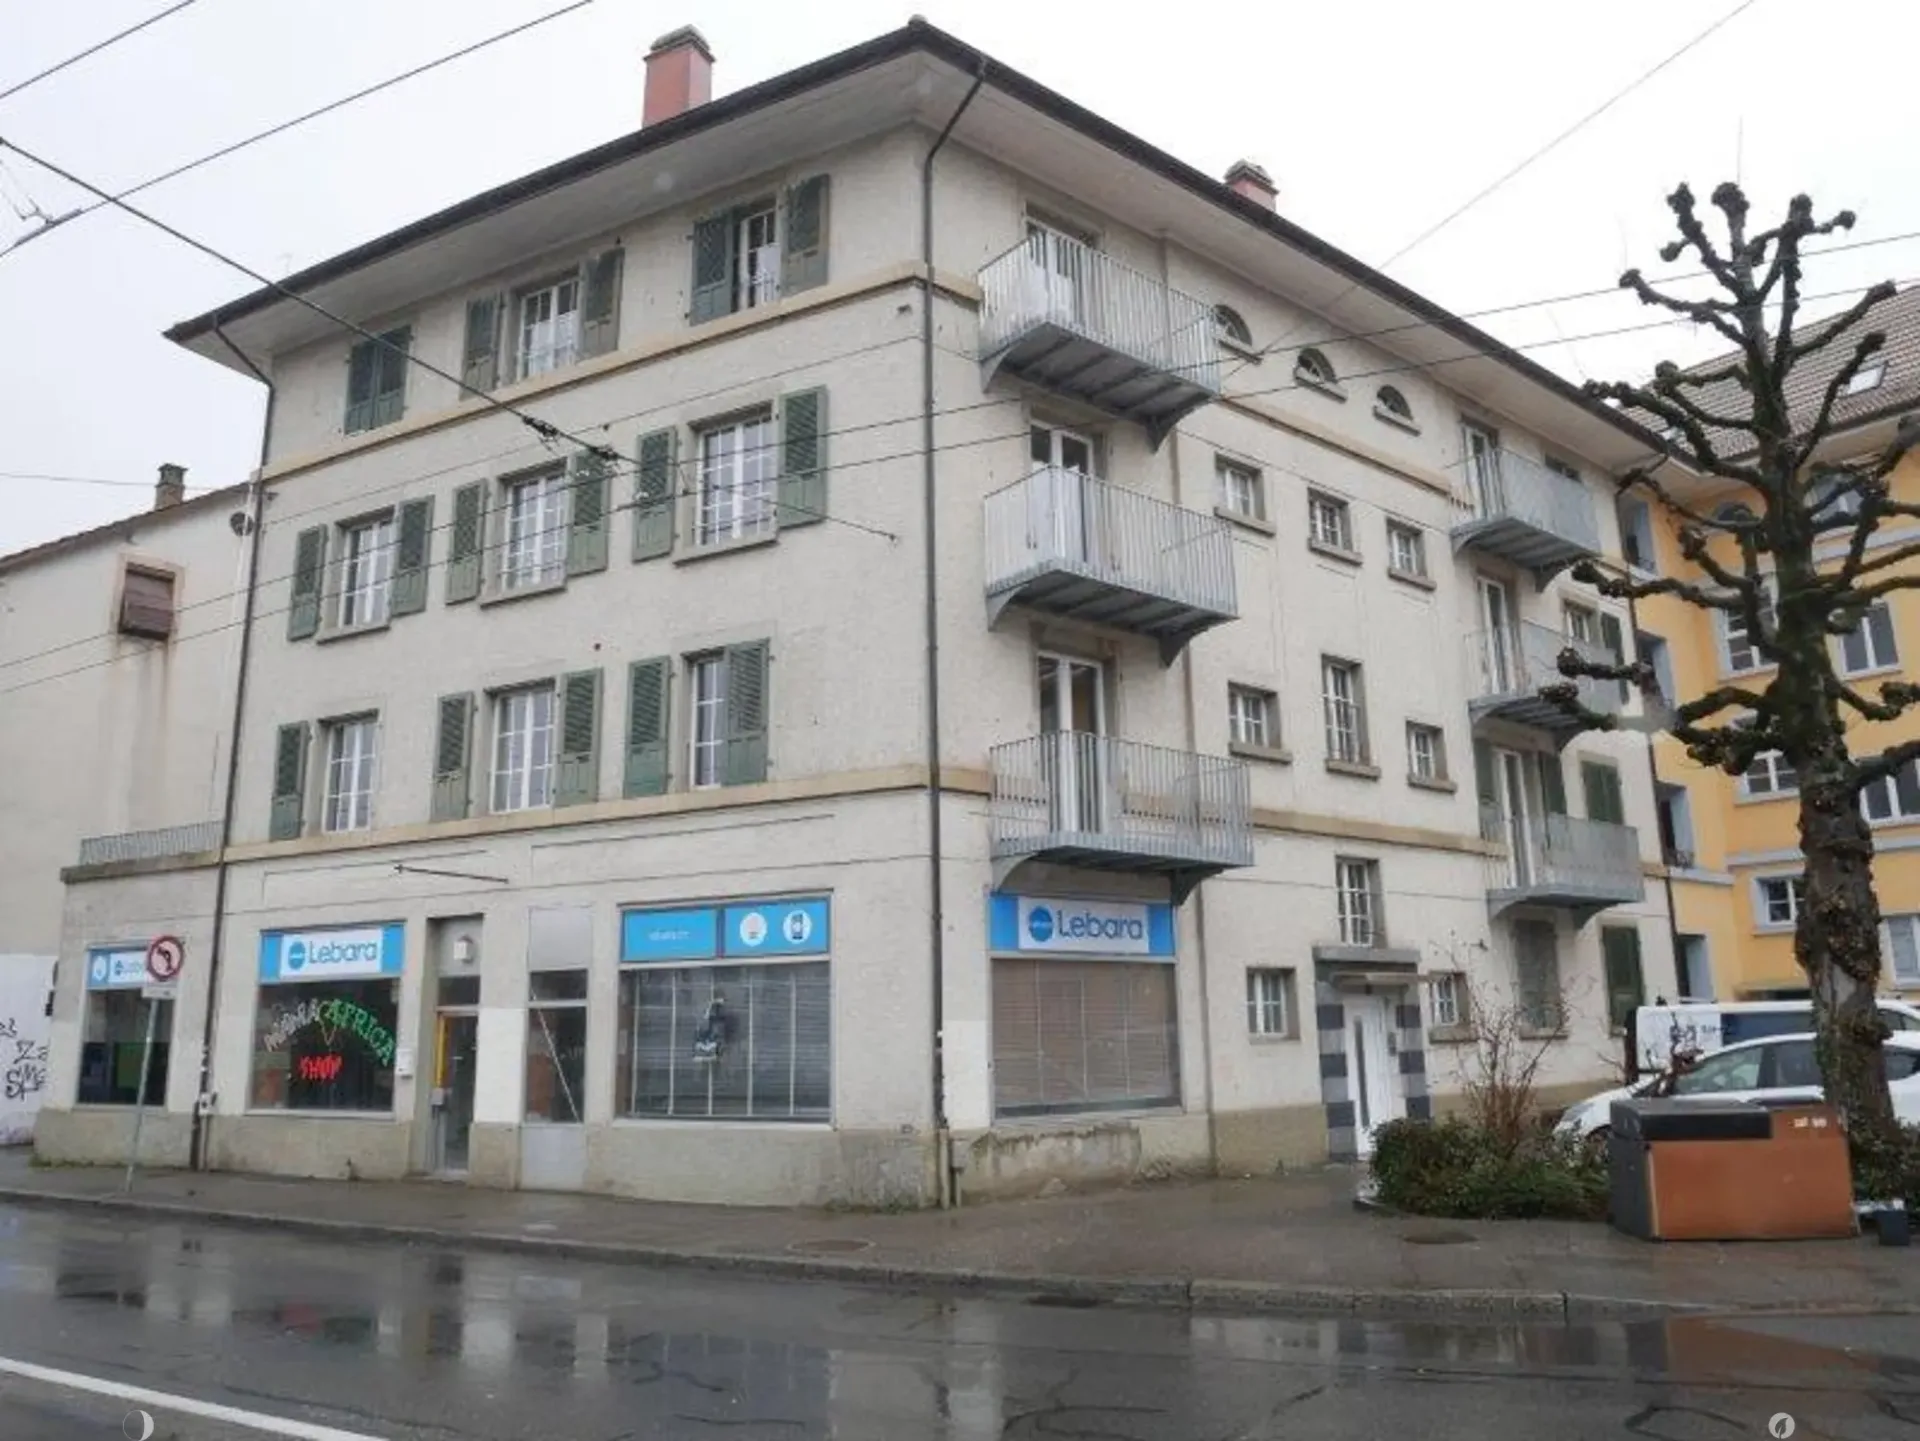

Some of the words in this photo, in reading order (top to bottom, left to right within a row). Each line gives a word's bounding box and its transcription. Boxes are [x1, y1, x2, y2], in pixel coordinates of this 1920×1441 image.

[1056, 909, 1143, 940] Lebara
[309, 941, 377, 964] Lebara
[324, 998, 395, 1067] AFRICA
